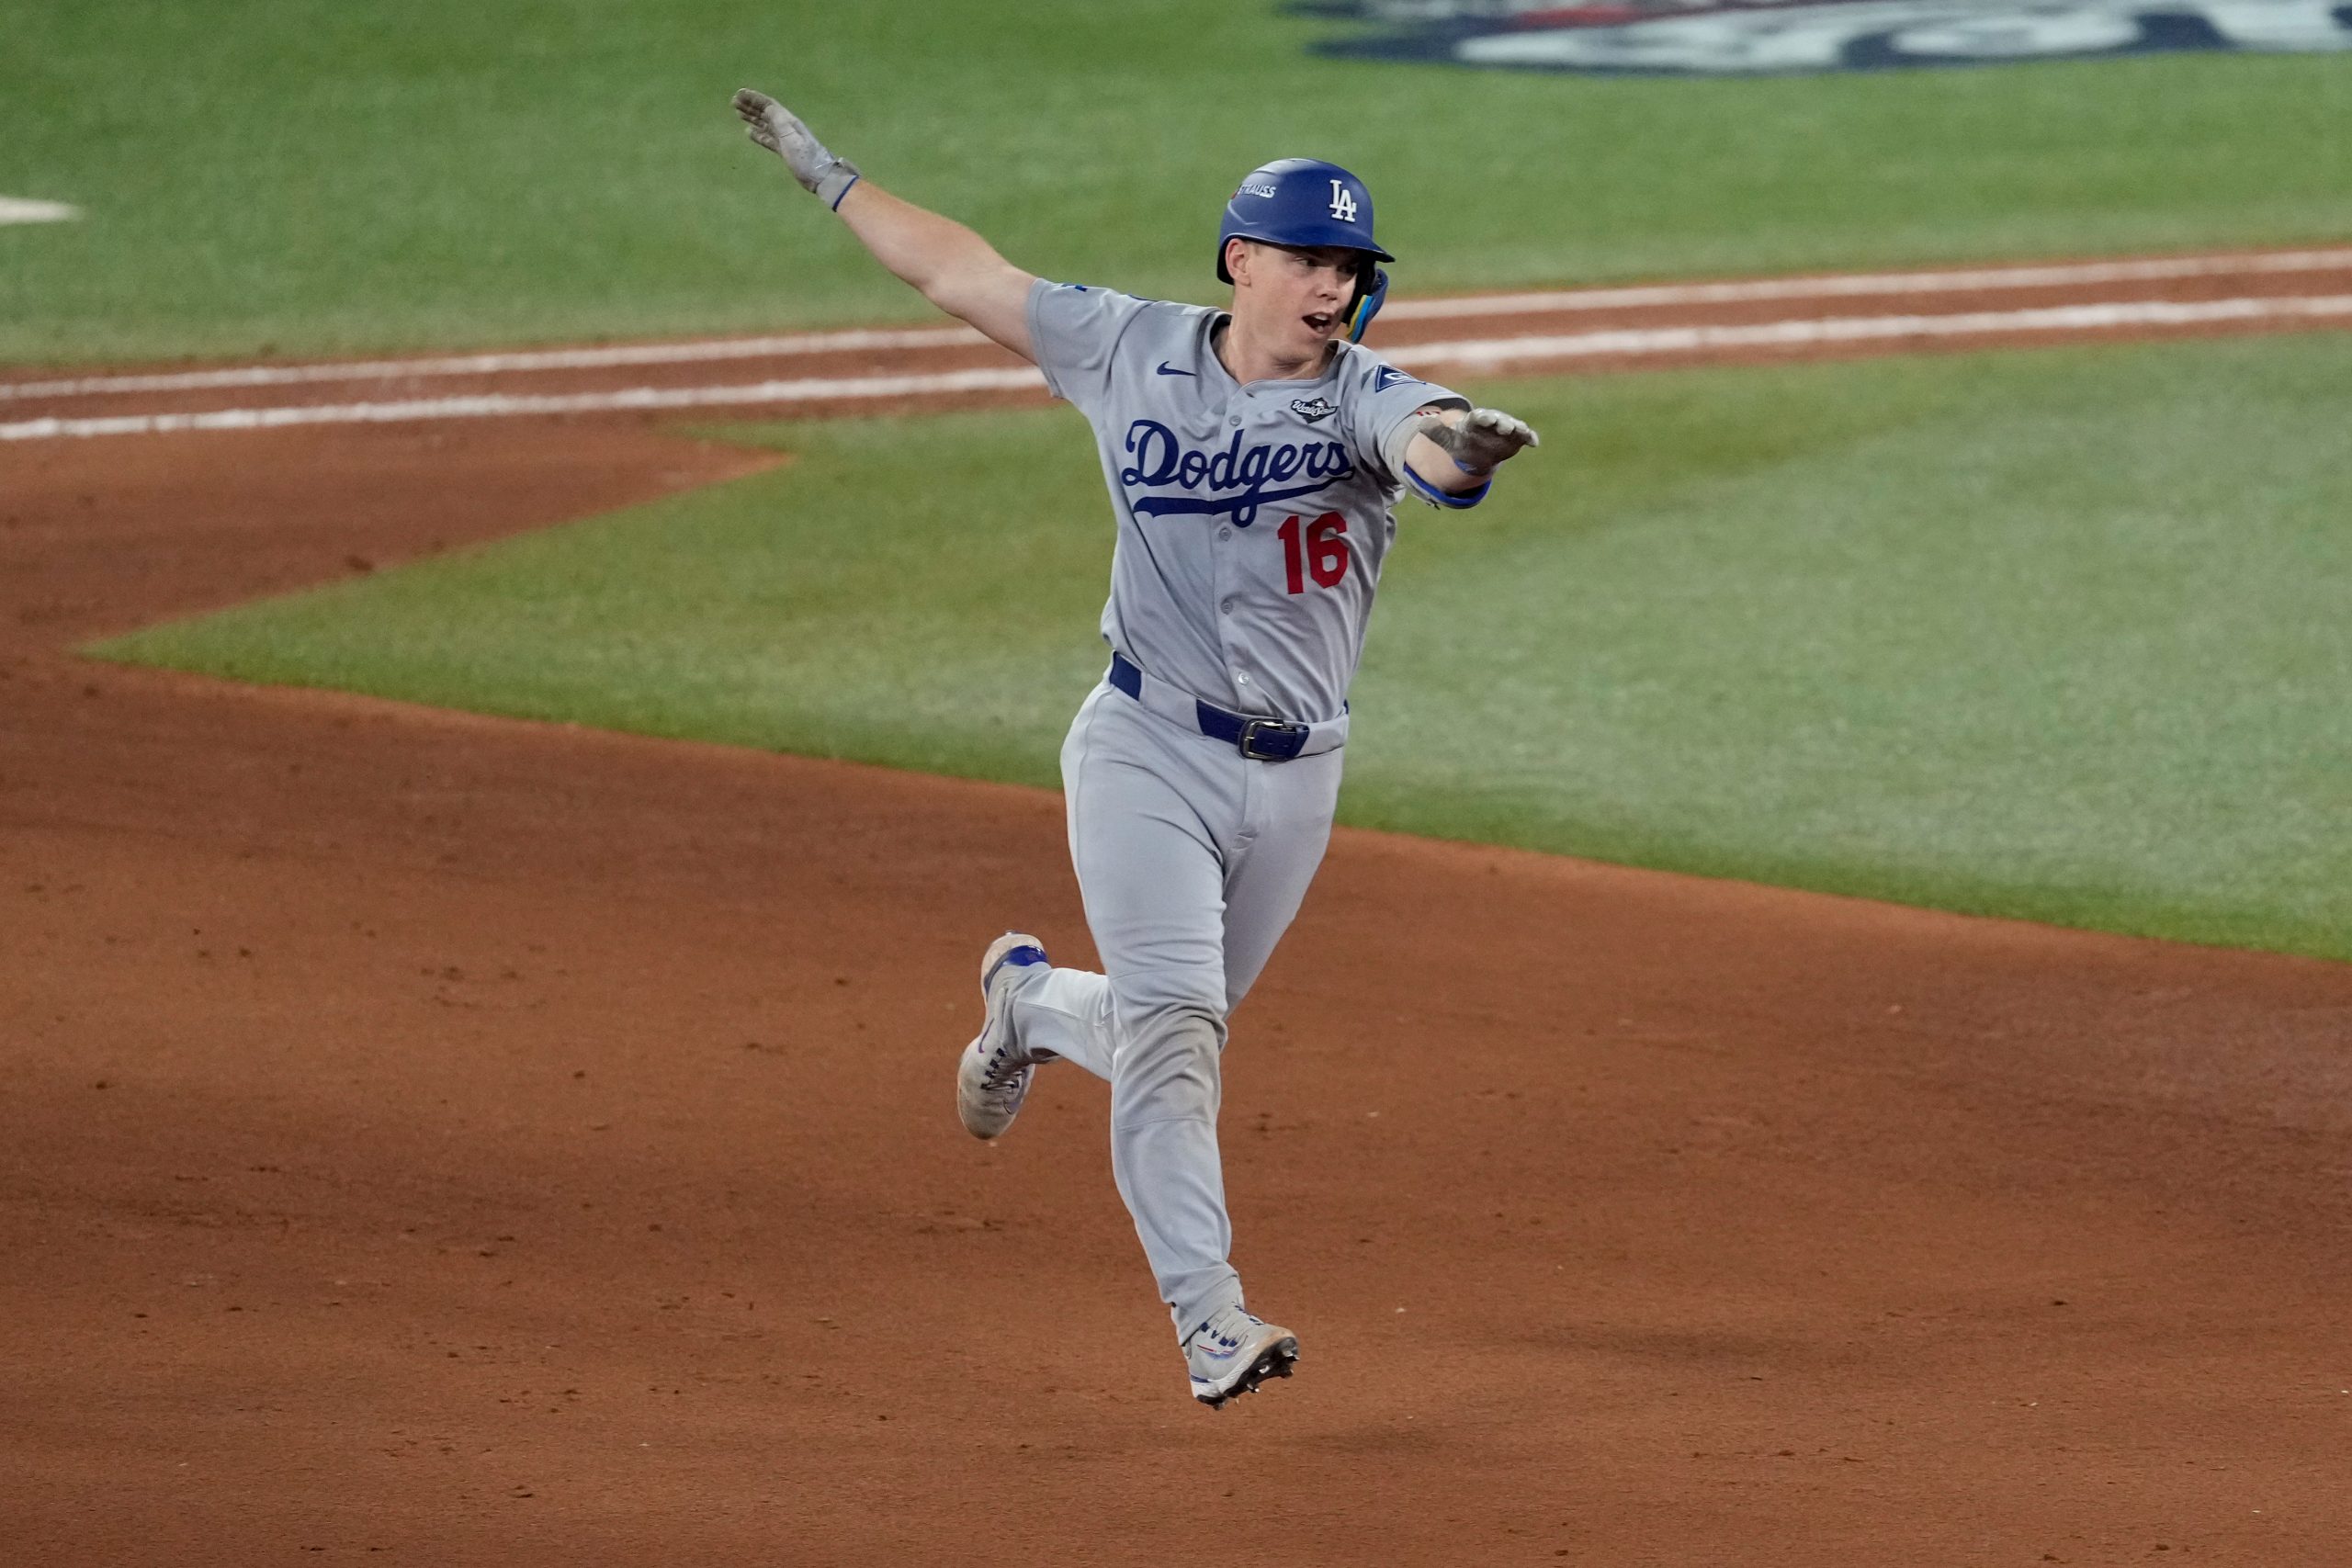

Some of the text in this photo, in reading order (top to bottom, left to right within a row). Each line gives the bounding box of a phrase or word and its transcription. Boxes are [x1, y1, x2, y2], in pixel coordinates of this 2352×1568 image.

[1329, 179, 1357, 222] LA
[1121, 419, 1353, 528] Dodgers
[1277, 511, 1349, 595] 16
